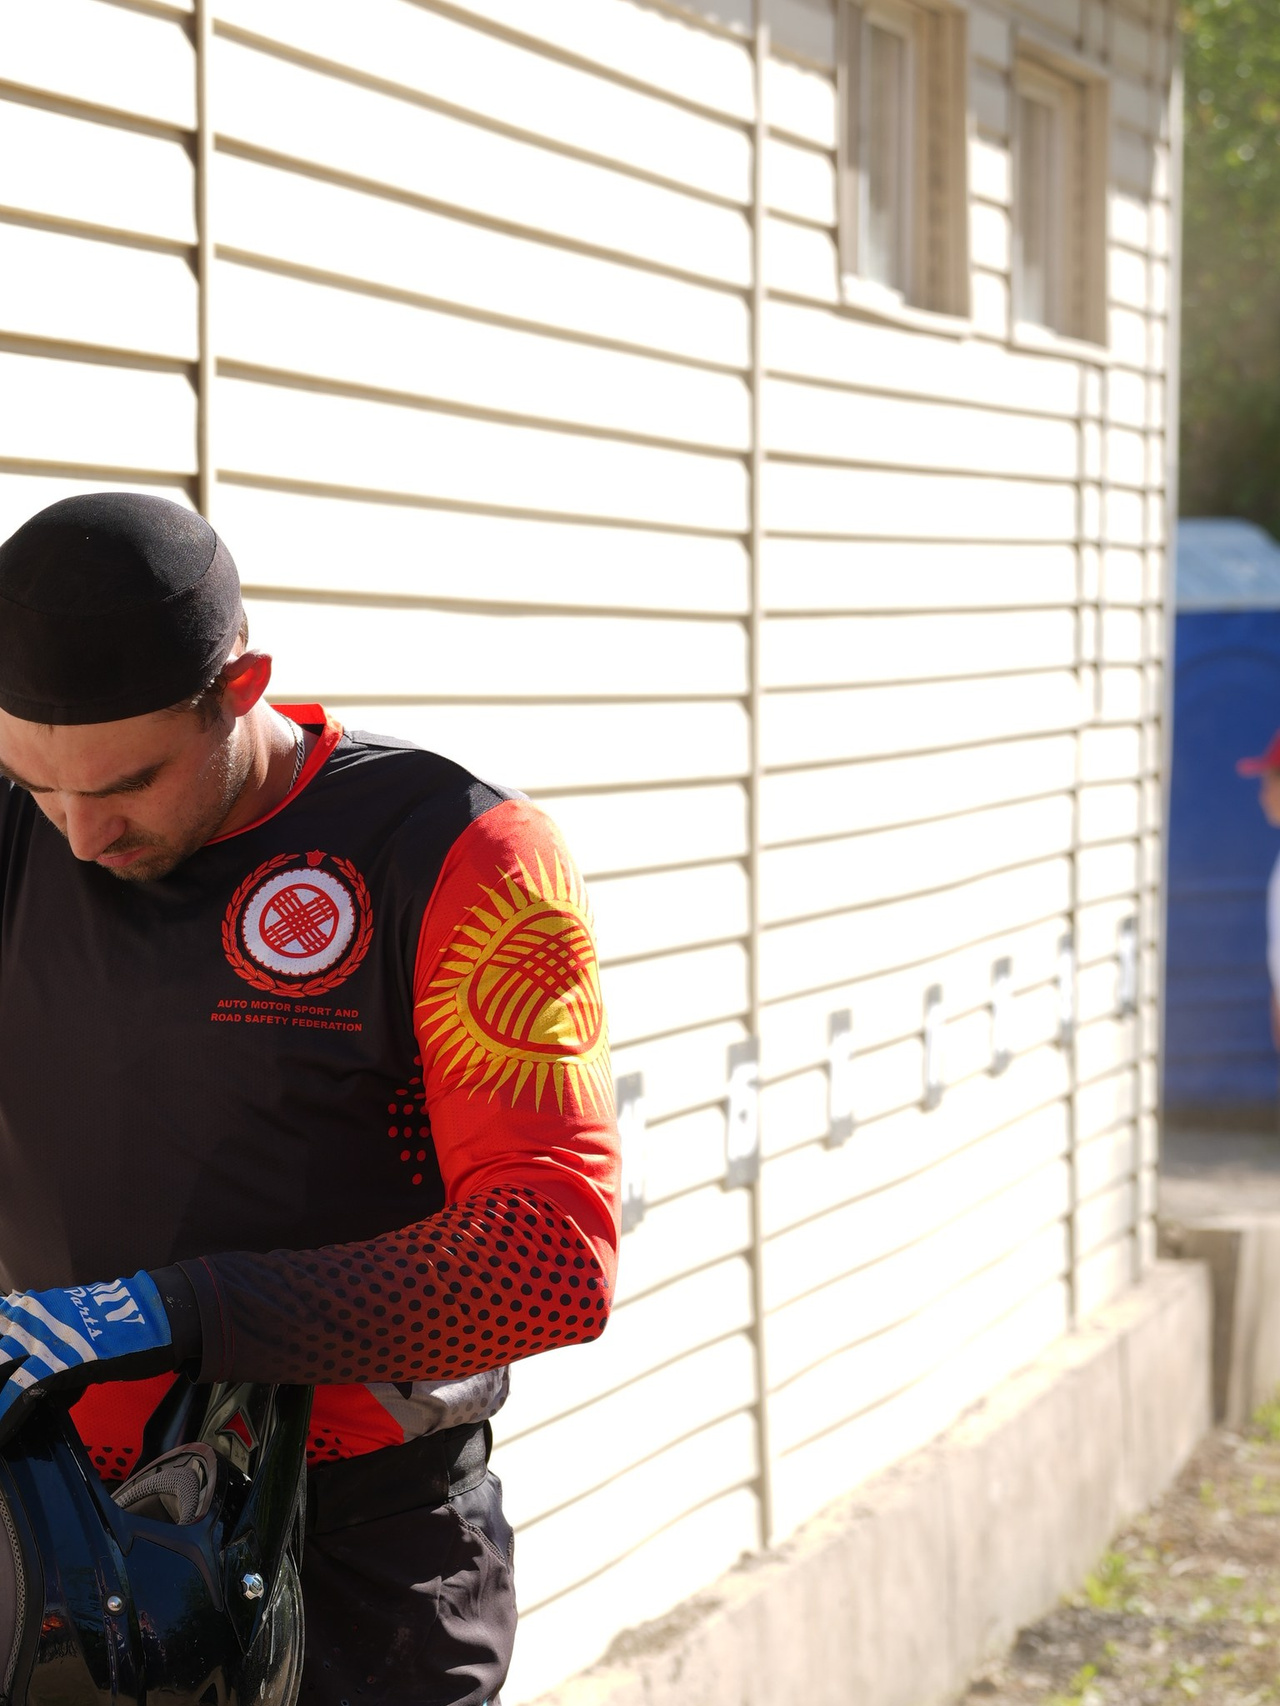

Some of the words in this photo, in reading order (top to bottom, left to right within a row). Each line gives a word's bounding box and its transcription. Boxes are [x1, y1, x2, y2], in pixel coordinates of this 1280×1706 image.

[217, 1000, 247, 1009] AUTO
[251, 1001, 291, 1012] MOTOR
[294, 1005, 331, 1016] SPORT
[334, 1008, 359, 1018] AND
[210, 1013, 241, 1022] ROAD
[245, 1014, 289, 1026] SAFETY
[292, 1017, 362, 1031] FEDERATION
[63, 1287, 103, 1341] Parts
